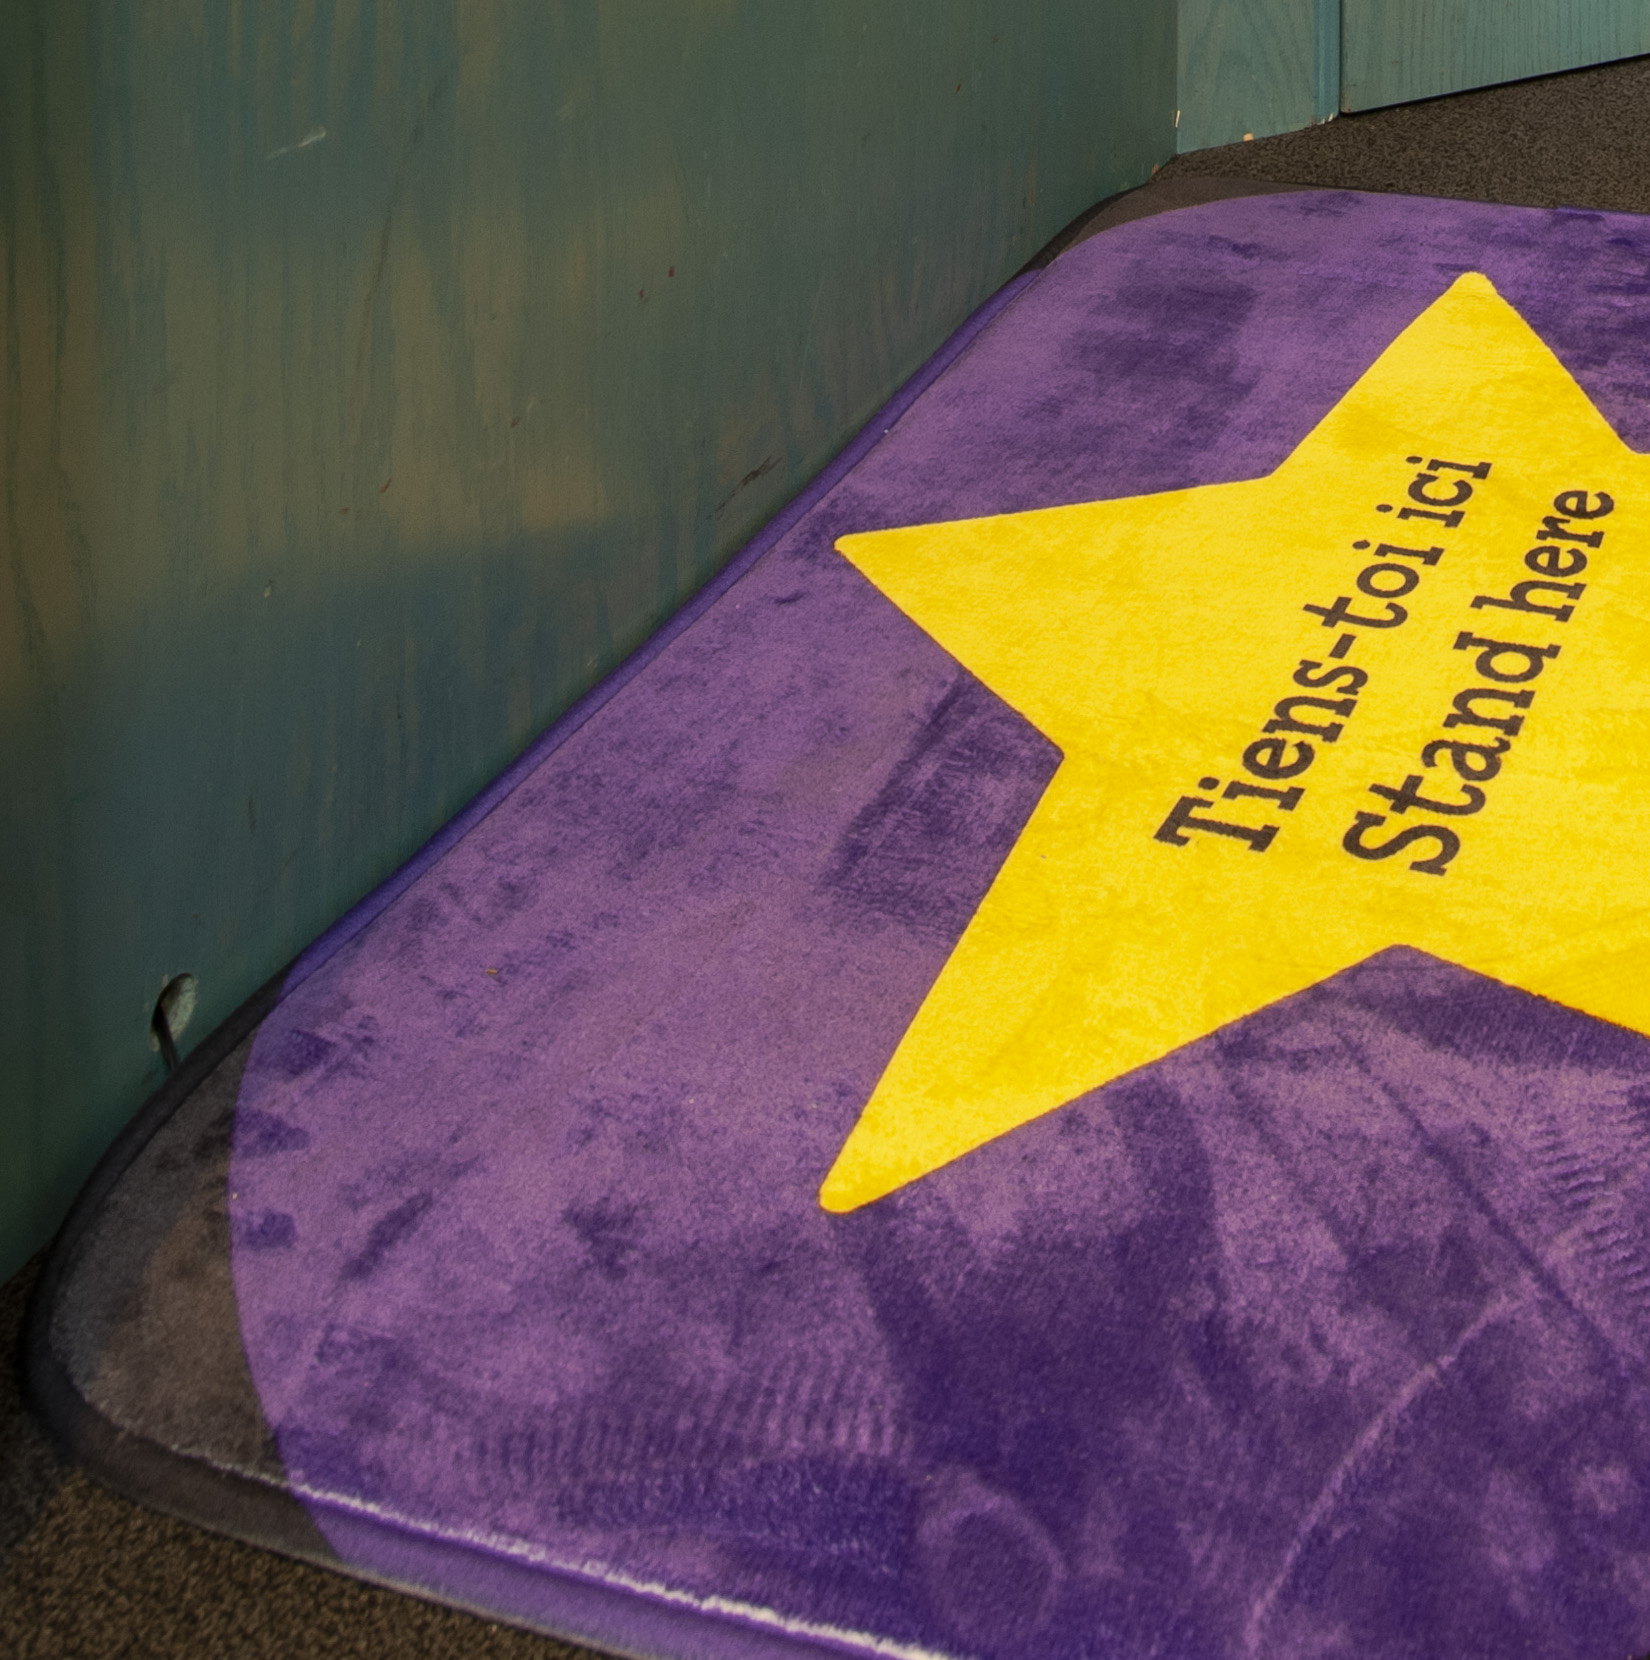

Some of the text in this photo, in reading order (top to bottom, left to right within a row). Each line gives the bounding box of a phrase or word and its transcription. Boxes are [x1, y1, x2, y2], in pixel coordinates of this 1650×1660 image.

[1153, 455, 1492, 853] Tiens-toi ici
[1342, 489, 1615, 876] Stand here
